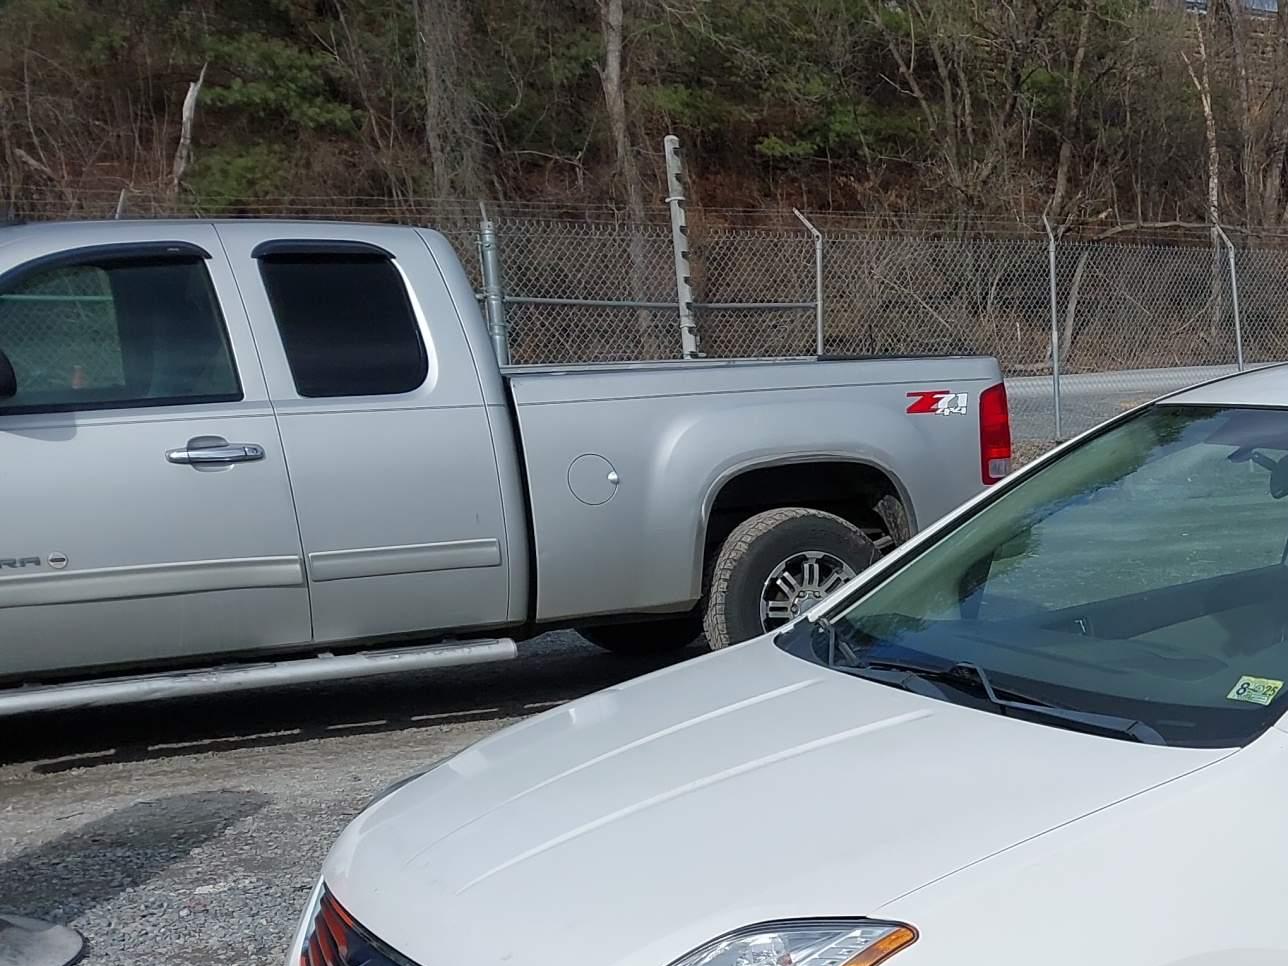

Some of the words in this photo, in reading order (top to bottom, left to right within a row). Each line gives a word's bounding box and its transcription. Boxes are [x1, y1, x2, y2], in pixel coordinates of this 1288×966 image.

[906, 390, 968, 414] Z71
[1236, 682, 1250, 695] 8
[1263, 685, 1279, 696] 25
